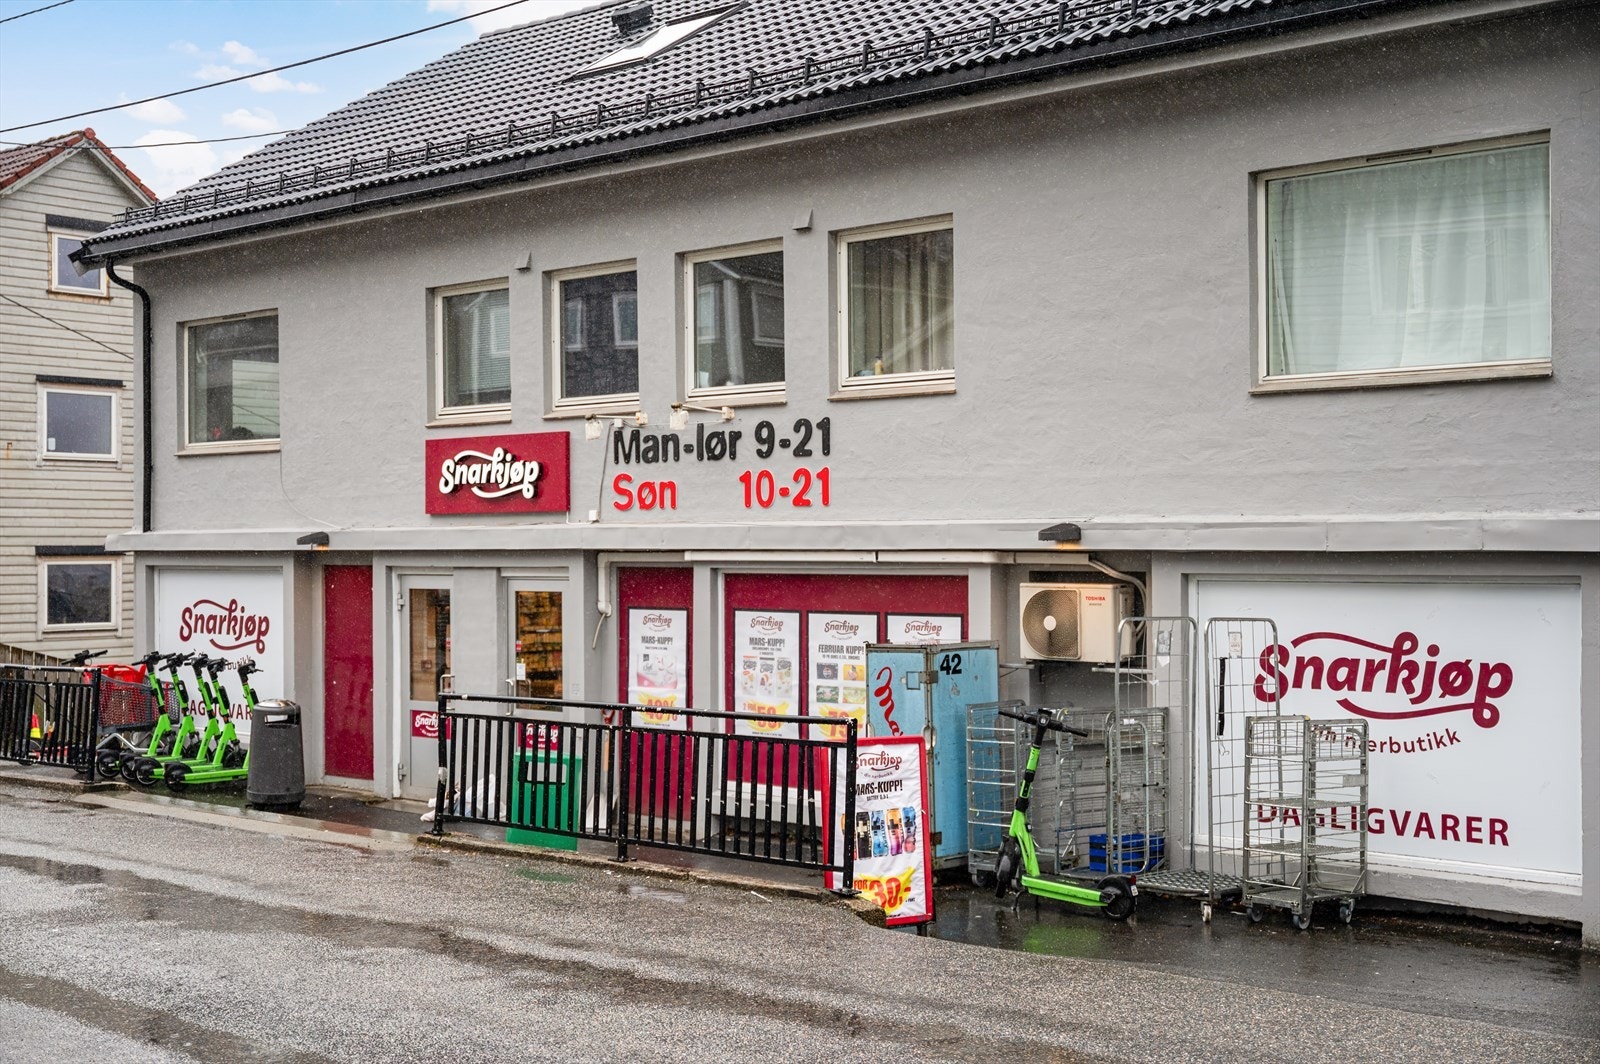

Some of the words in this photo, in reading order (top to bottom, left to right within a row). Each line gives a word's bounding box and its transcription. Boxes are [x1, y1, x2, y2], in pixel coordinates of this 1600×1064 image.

[613, 422, 742, 465] Man-lør
[754, 416, 831, 459] 9-21
[438, 446, 540, 499] Snarkjøp
[612, 472, 678, 511] Søn
[738, 466, 831, 509] 10-21
[179, 598, 270, 655] Snarkjøp
[642, 613, 673, 628] Snarkjøp
[750, 615, 784, 632] Snarkjøp
[824, 619, 860, 636] Snarkjøp
[904, 620, 943, 636] Snarkjøp
[641, 635, 673, 645] MARS-KUPP!
[749, 637, 785, 648] MARS-KUPP!
[818, 644, 845, 654] FEBRUAR
[845, 645, 864, 655] KUPP!
[939, 653, 962, 675] 42
[1252, 631, 1514, 729] Snarkjøp
